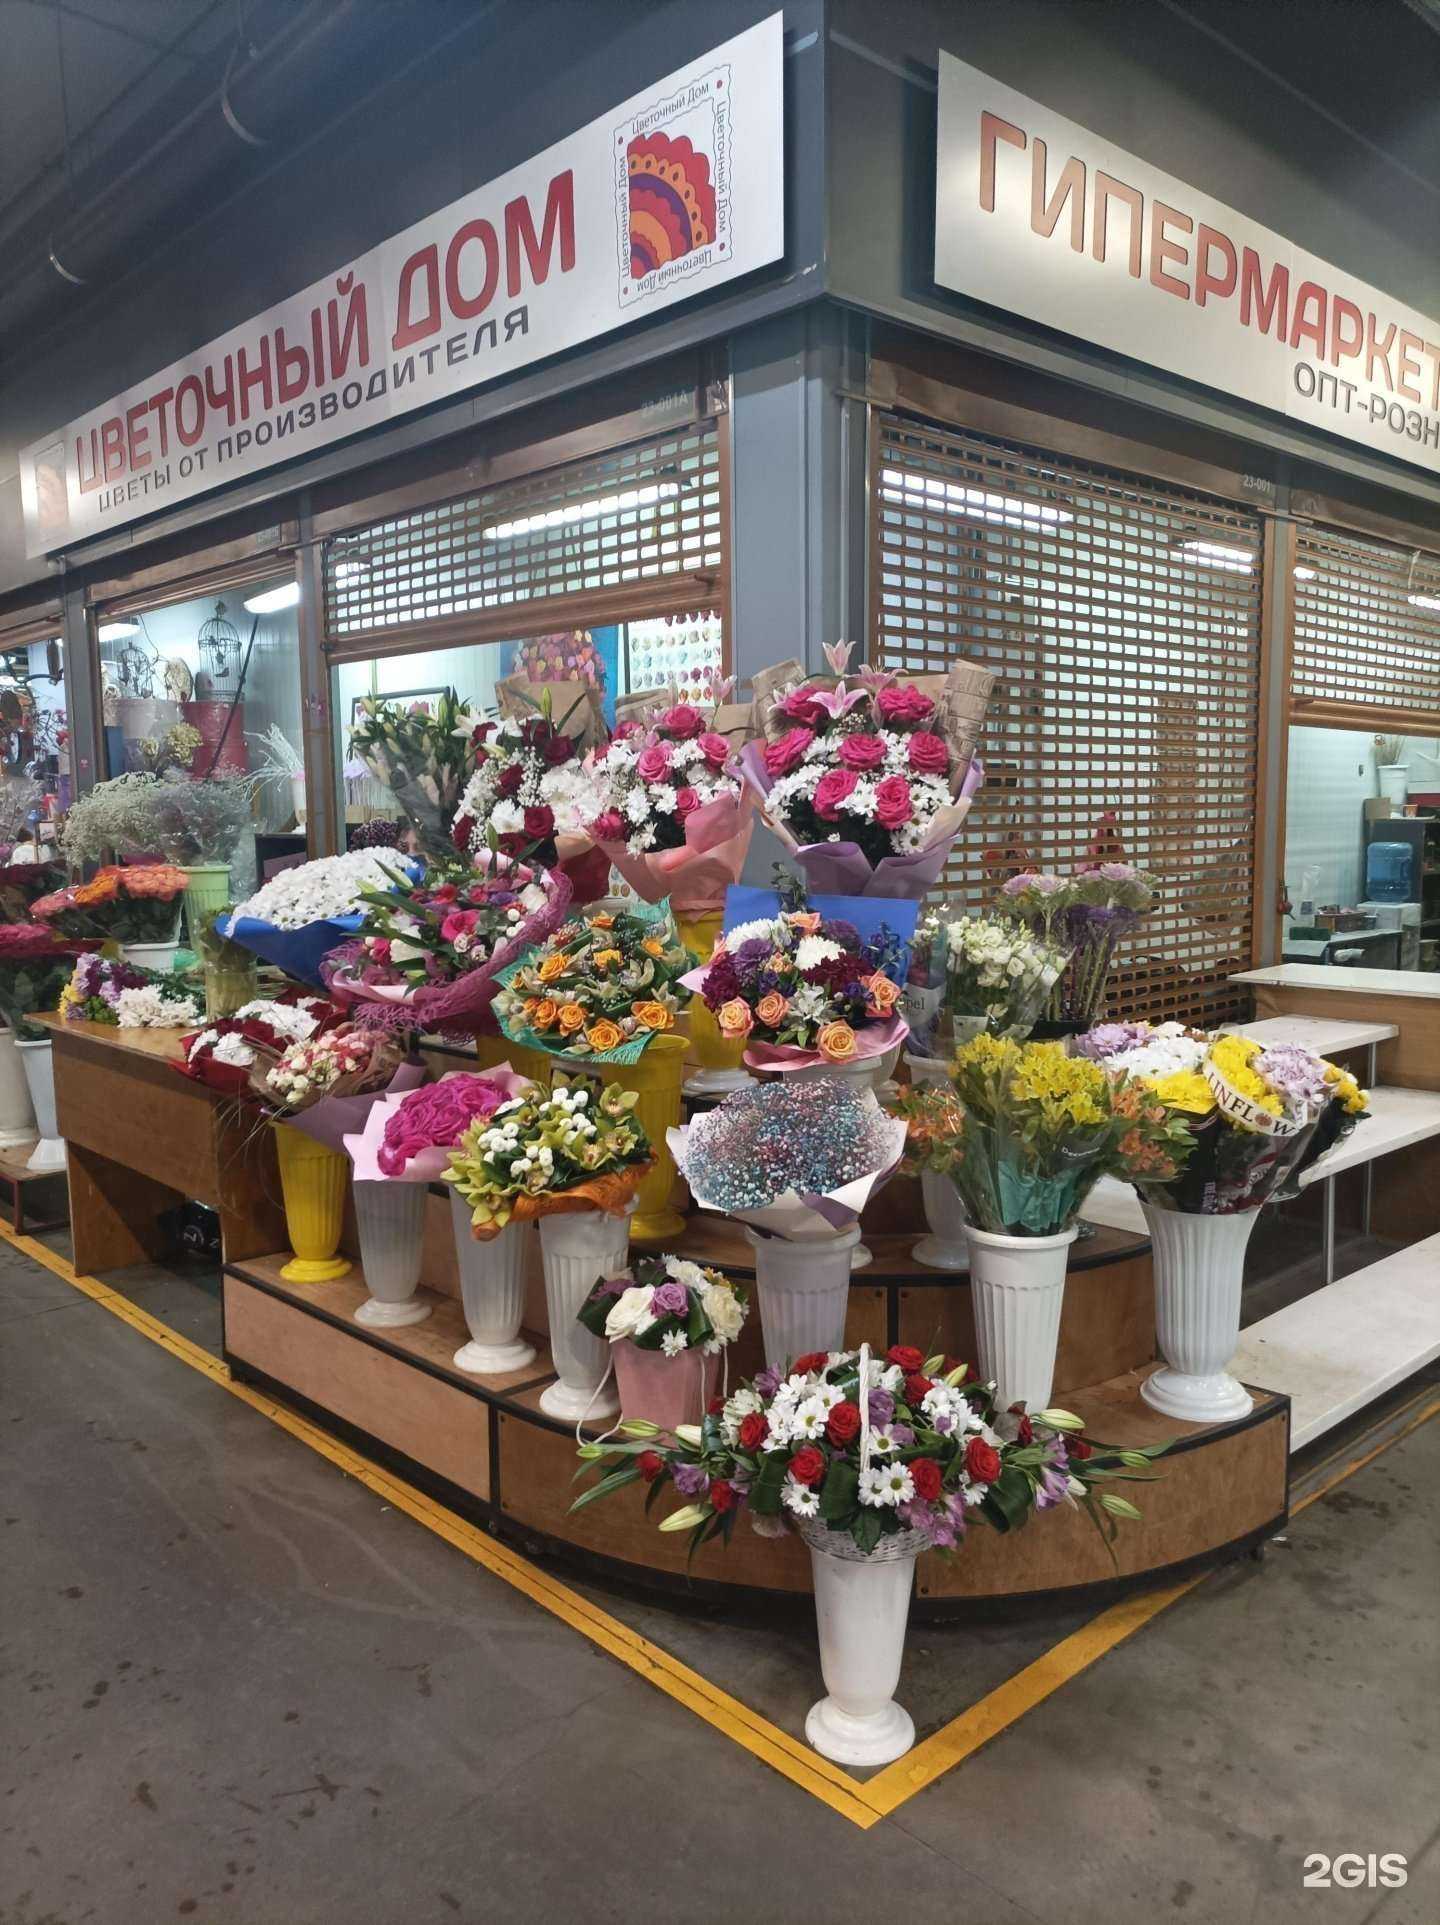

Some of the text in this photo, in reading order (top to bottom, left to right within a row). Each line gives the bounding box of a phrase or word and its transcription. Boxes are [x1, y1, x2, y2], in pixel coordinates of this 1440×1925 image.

[632, 82, 709, 135] Цветочный Дом
[716, 100, 728, 233] Цветочный Дом
[618, 156, 631, 279] Цветочный Дом
[637, 250, 712, 291] Цветочный Дом
[979, 110, 1440, 411] ГИПЕРМАРКЕТ
[76, 169, 576, 494] ЦВЕТОЧНЫЙ ДОМ
[99, 304, 529, 512] ЦВЕТЫ ОТ ПРОИЗВОДИТЕЛЯ
[1243, 474, 1271, 492] 23-001
